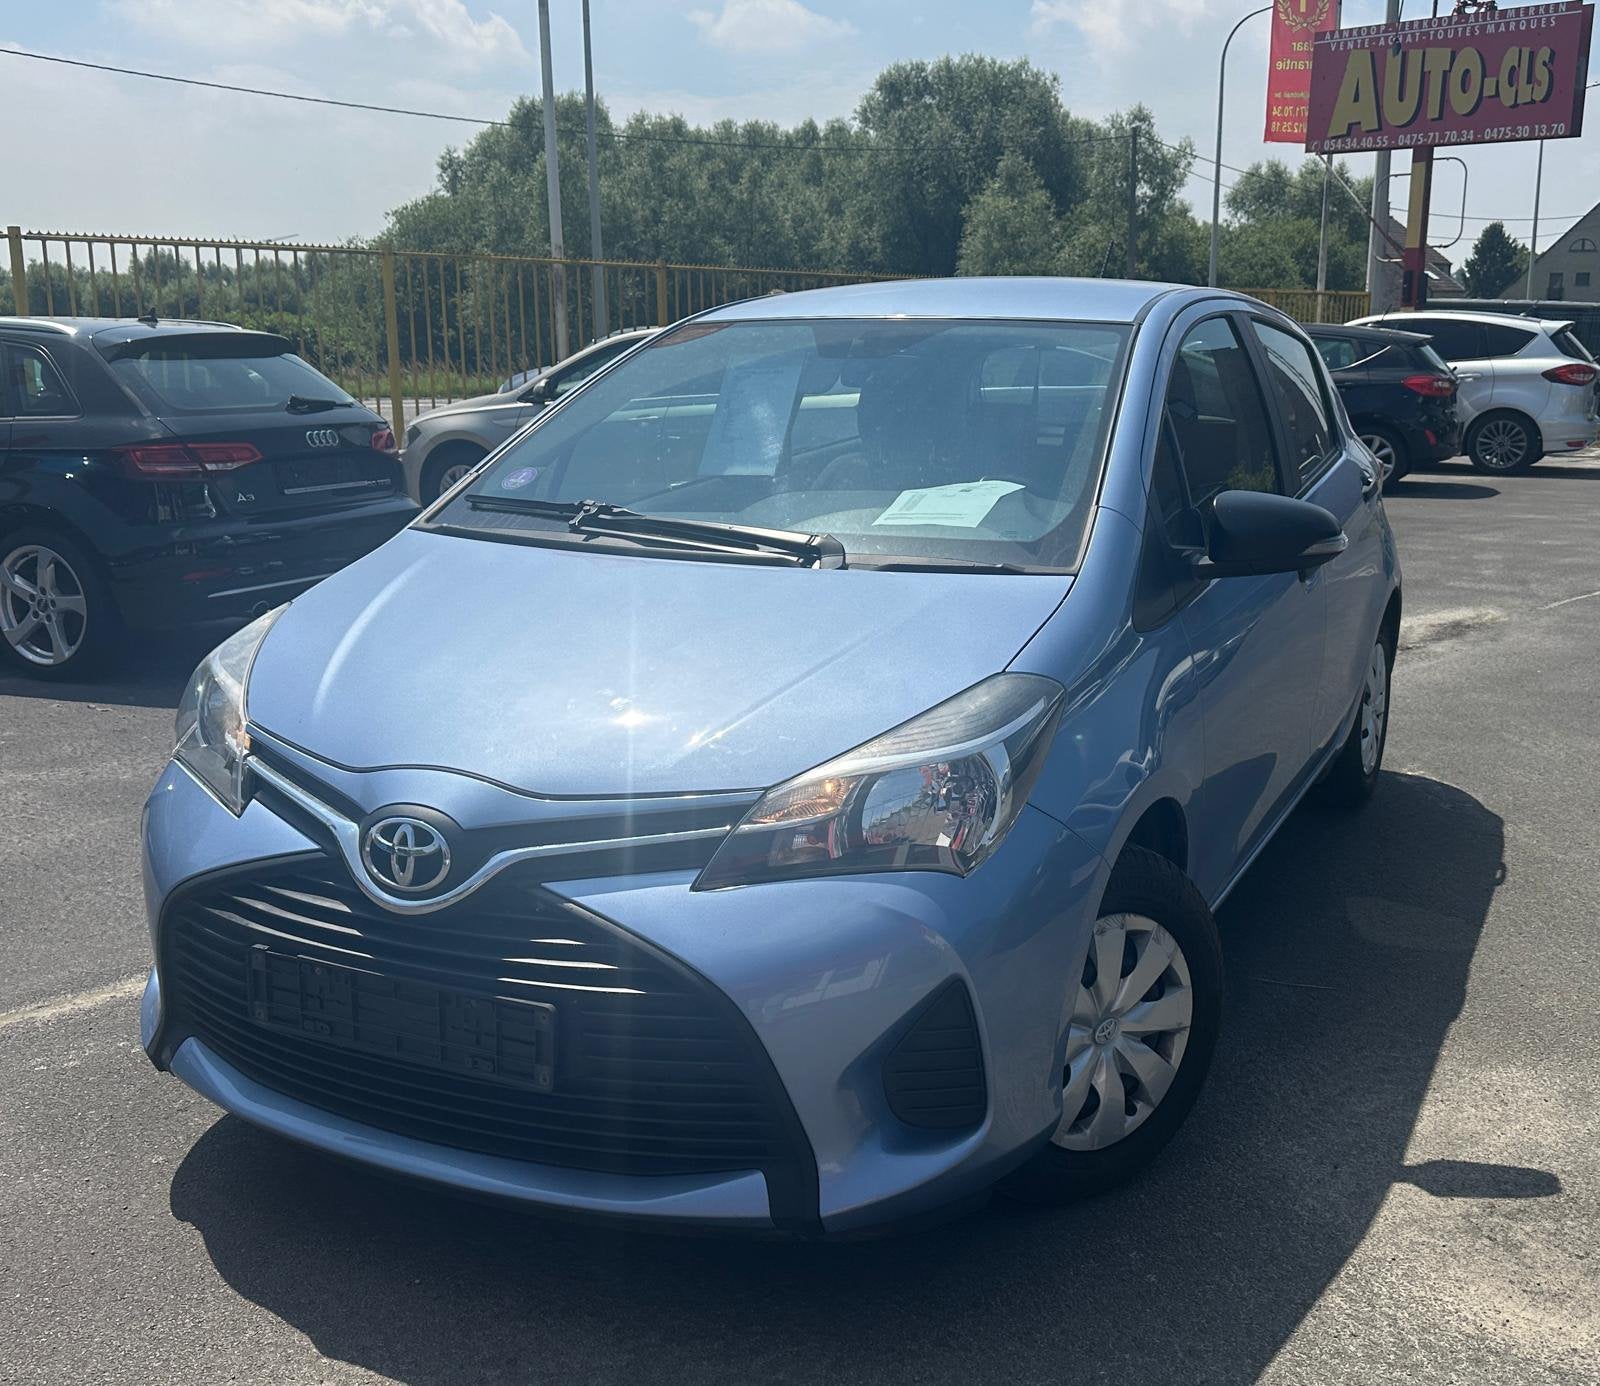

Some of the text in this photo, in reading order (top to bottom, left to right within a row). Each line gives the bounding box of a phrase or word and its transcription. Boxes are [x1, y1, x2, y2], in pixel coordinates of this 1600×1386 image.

[1506, 3, 1567, 18] MERKEN
[1486, 16, 1556, 34] MARQUES
[1327, 46, 1555, 139] AUTO-CLS
[1323, 136, 1389, 151] 054-34.40.55
[1398, 130, 1474, 146] 0475-71.70.34
